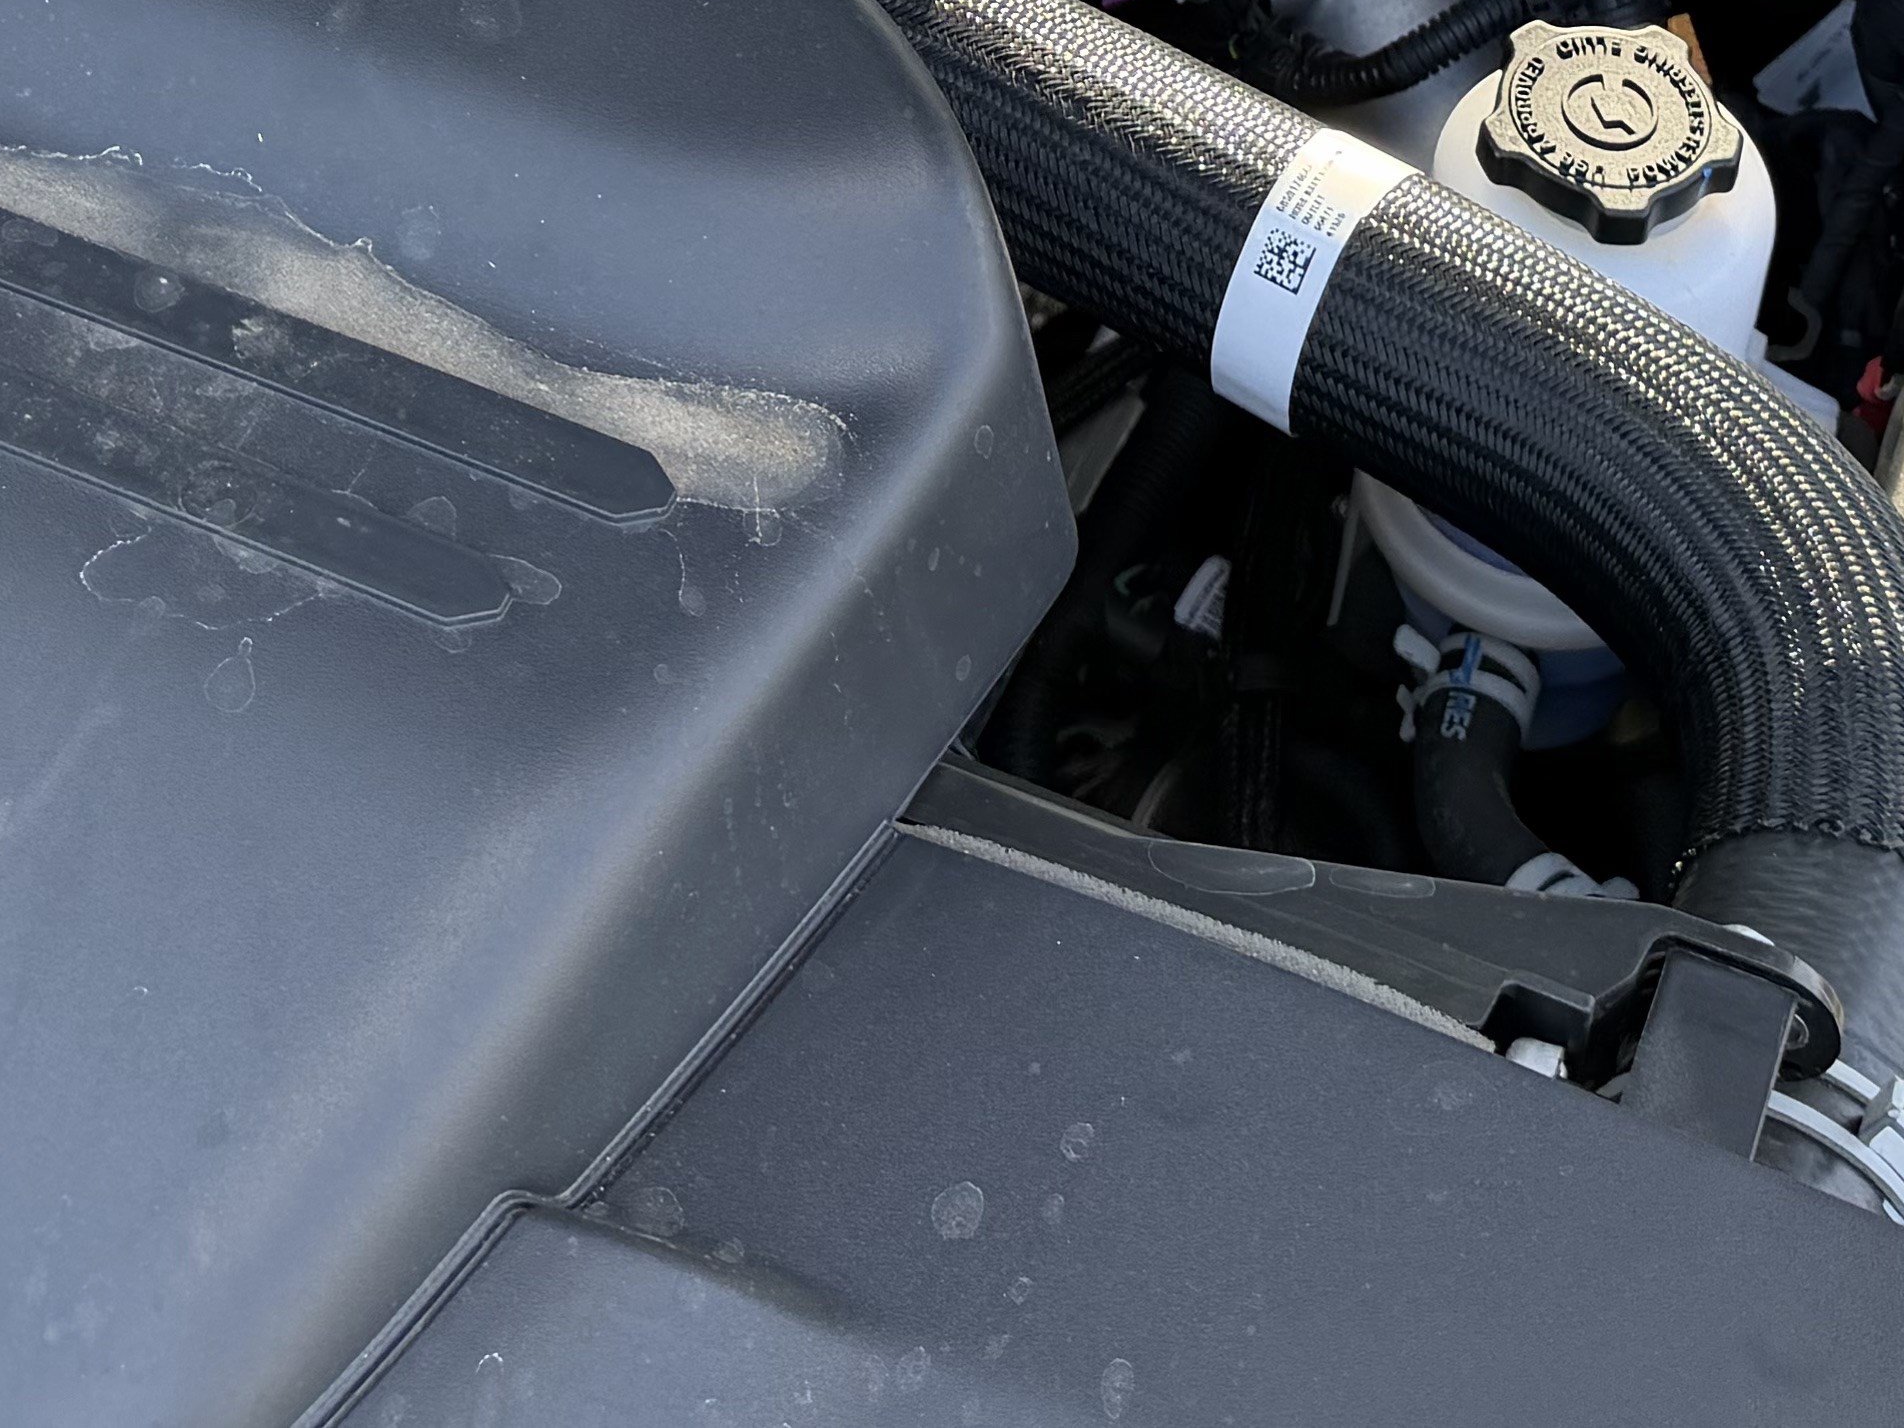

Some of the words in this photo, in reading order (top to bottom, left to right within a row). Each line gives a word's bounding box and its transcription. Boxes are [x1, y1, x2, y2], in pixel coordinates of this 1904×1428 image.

[1514, 57, 1556, 156] APPROVED
[1558, 151, 1605, 184] USE
[1625, 135, 1699, 185] POWER
[1439, 691, 1477, 741] RES
